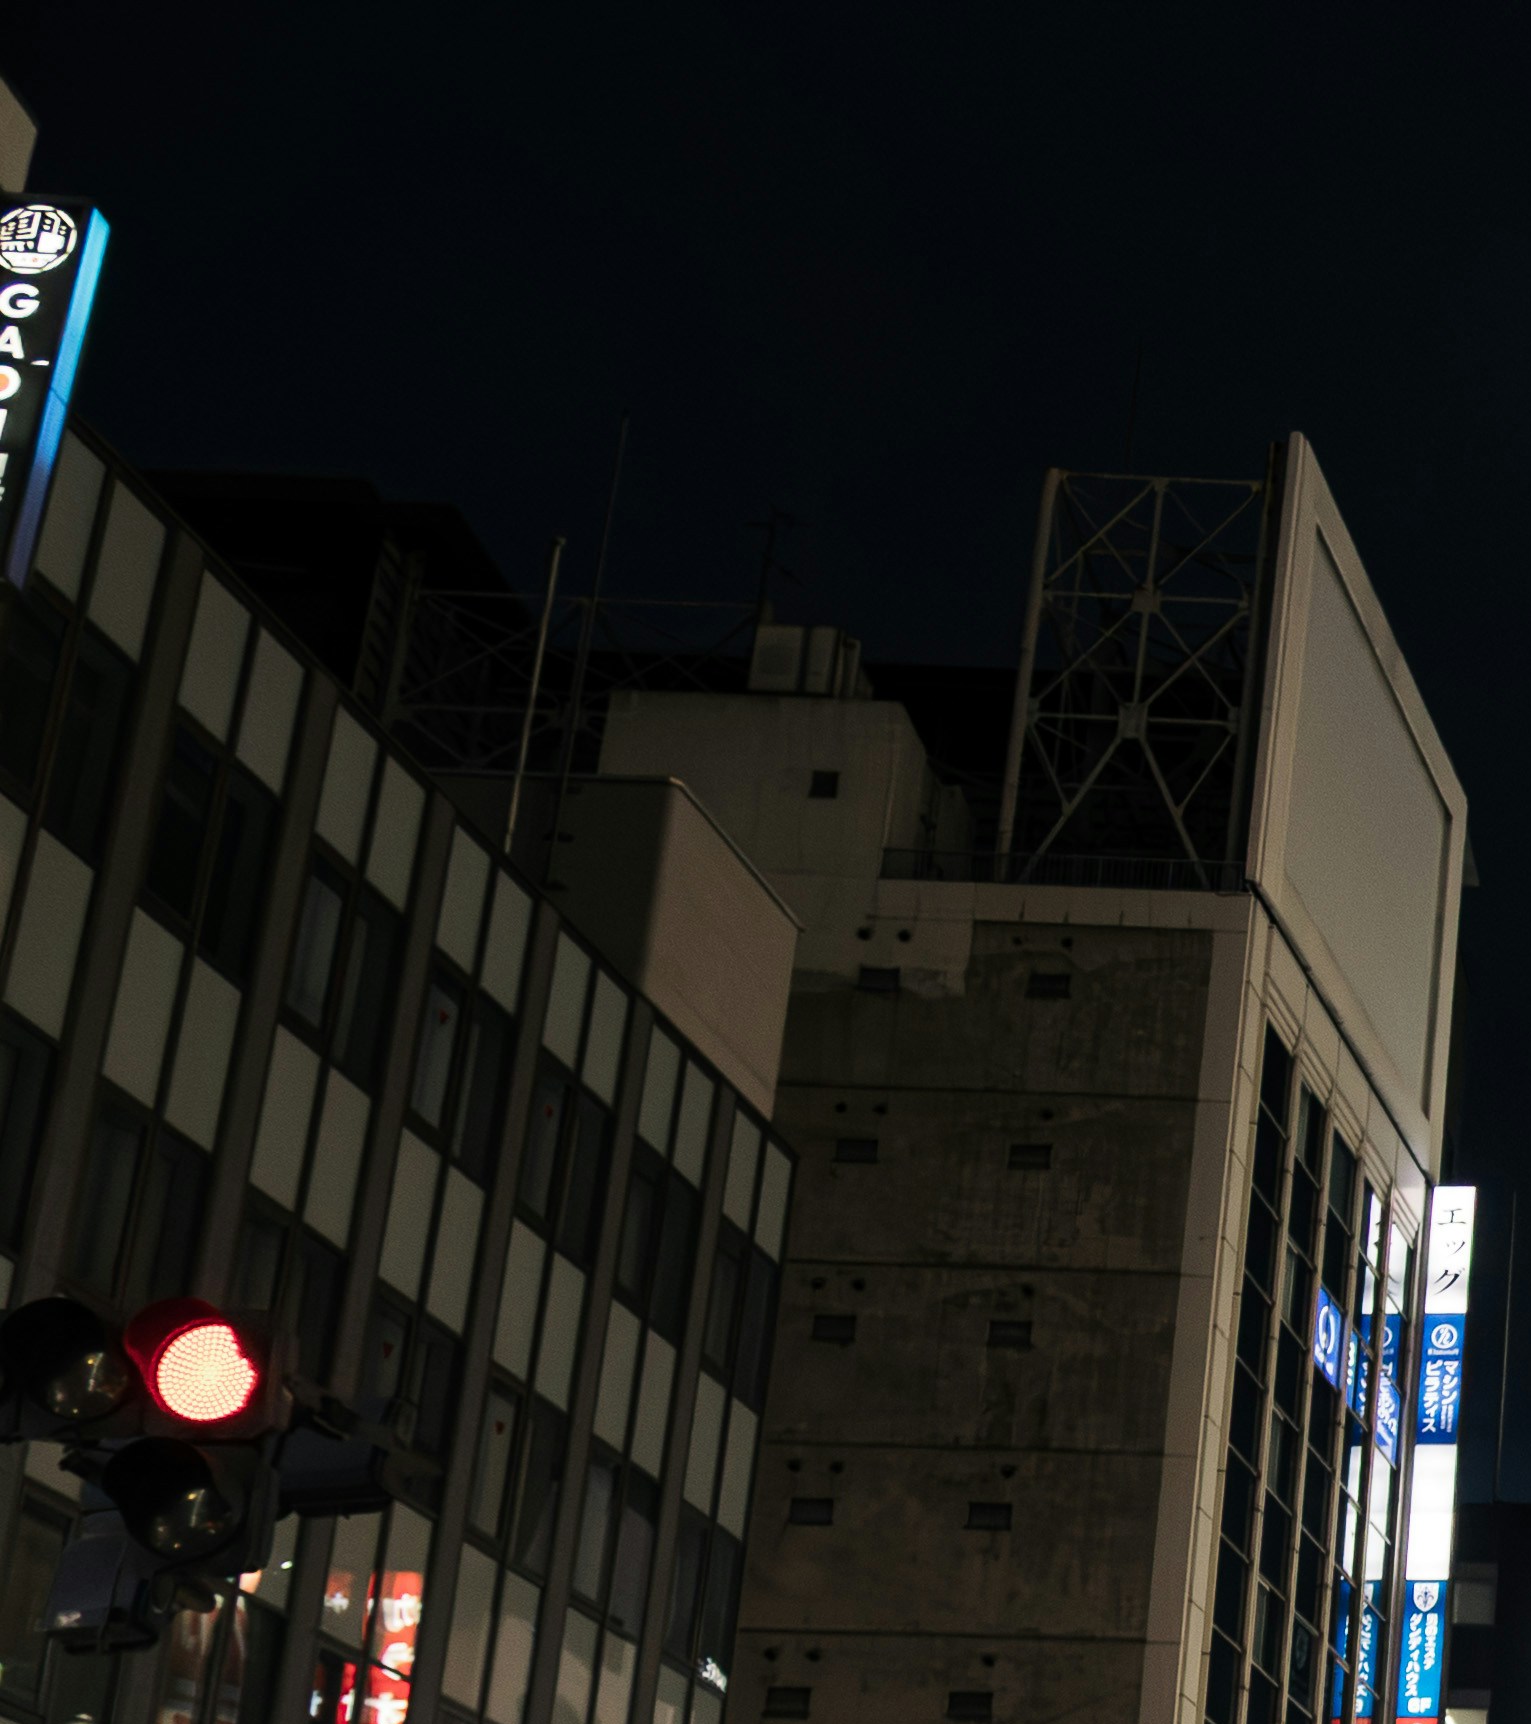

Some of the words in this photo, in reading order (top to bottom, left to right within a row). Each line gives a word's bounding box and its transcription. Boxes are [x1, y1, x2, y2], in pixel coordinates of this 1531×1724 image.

[1438, 1207, 1467, 1295] エッグ
[1421, 1359, 1443, 1433] ピラティス
[1442, 1360, 1460, 1405] マシン
